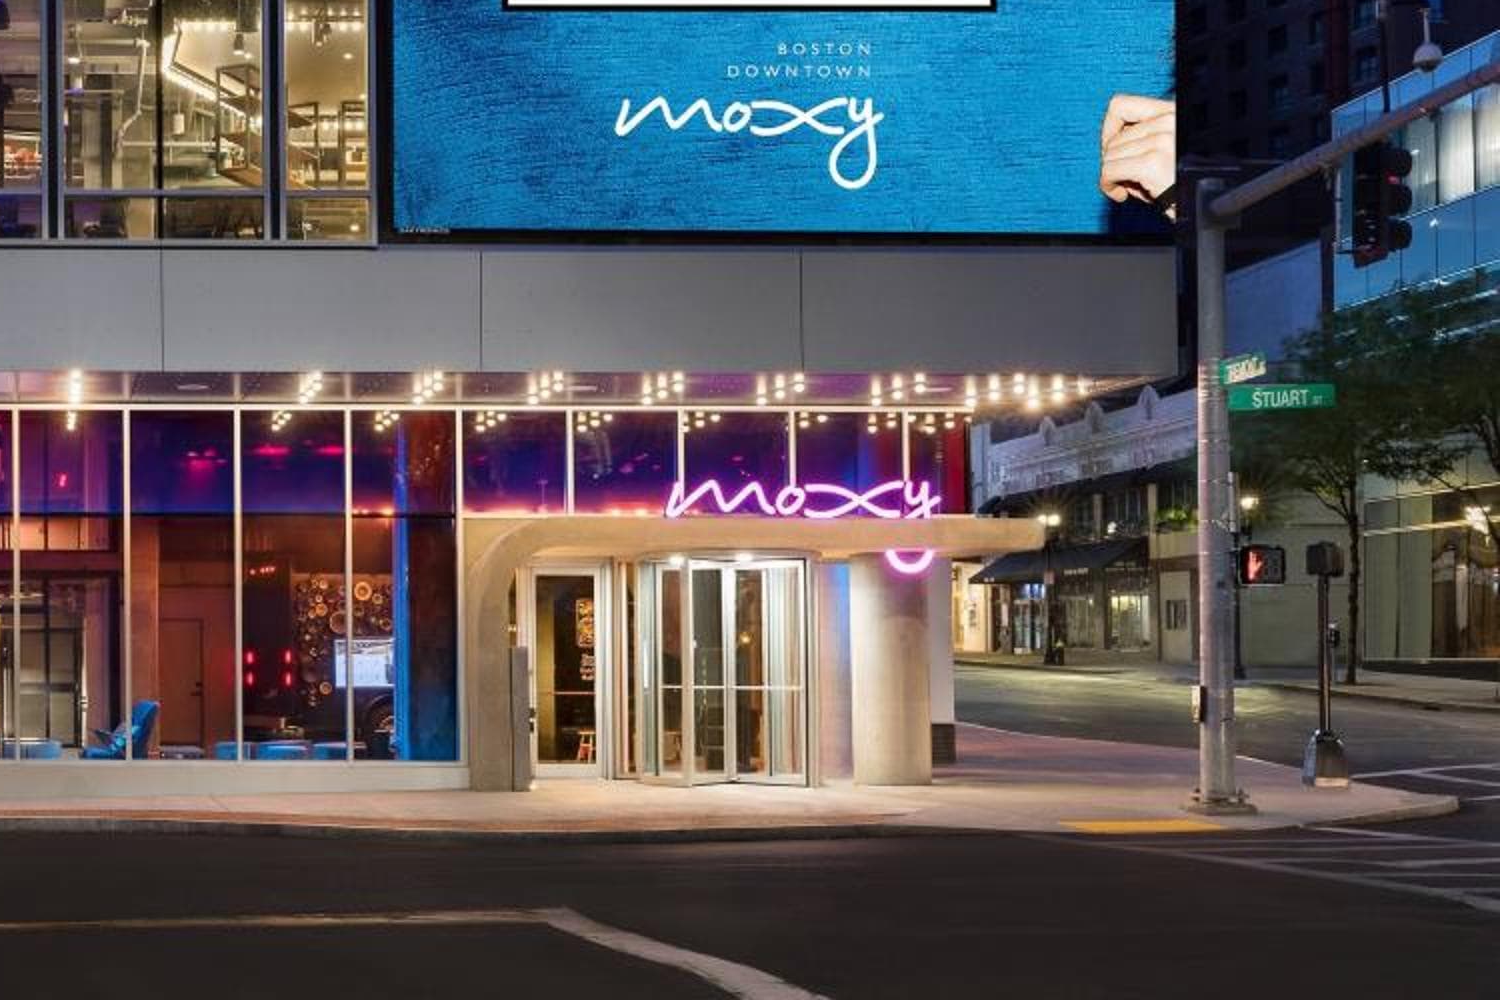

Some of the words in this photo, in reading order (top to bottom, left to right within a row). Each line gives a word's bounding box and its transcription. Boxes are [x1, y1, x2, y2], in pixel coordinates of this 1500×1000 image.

[778, 42, 872, 56] BOSTON
[727, 64, 872, 78] DOWNTOWN
[615, 95, 884, 189] moxy
[1251, 389, 1308, 408] STUART
[666, 479, 941, 574] moxy
